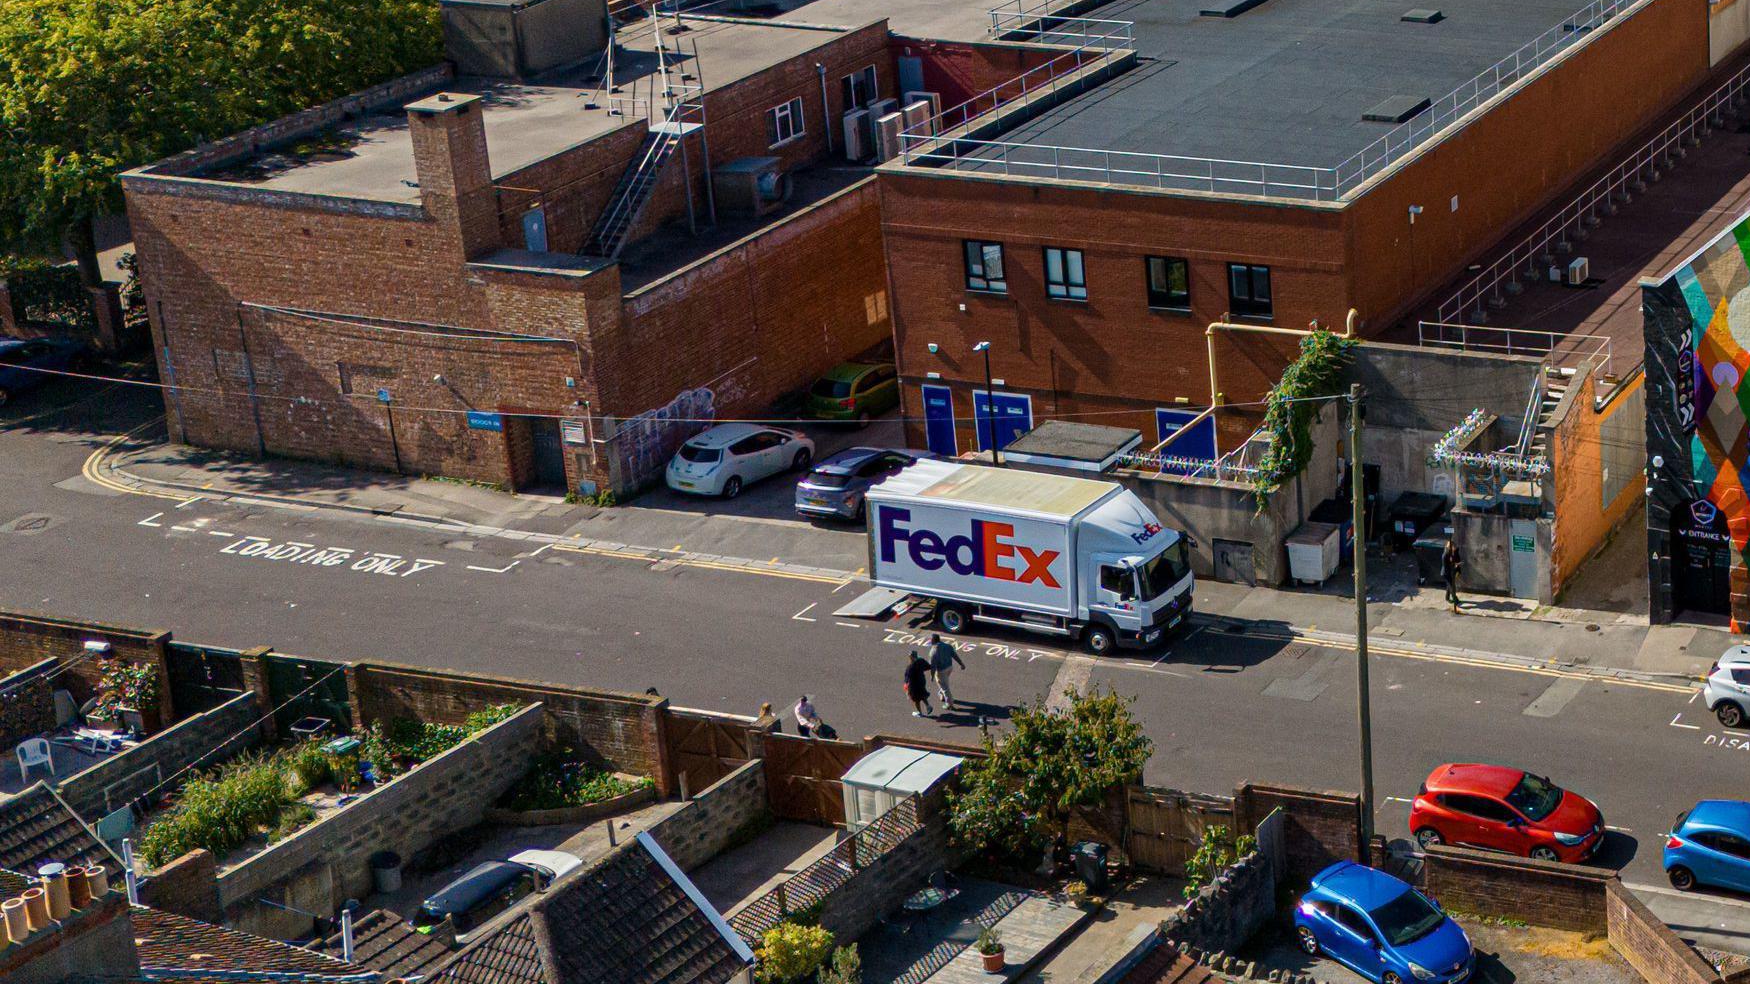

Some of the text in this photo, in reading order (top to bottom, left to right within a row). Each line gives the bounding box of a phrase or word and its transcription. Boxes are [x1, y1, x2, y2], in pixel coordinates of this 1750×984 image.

[1131, 522, 1162, 545] FedEx
[1688, 529, 1720, 541] ENTRANCE
[219, 539, 435, 578] LOADING ONLY
[878, 505, 1063, 589] FedEx
[985, 645, 1043, 663] ONLY
